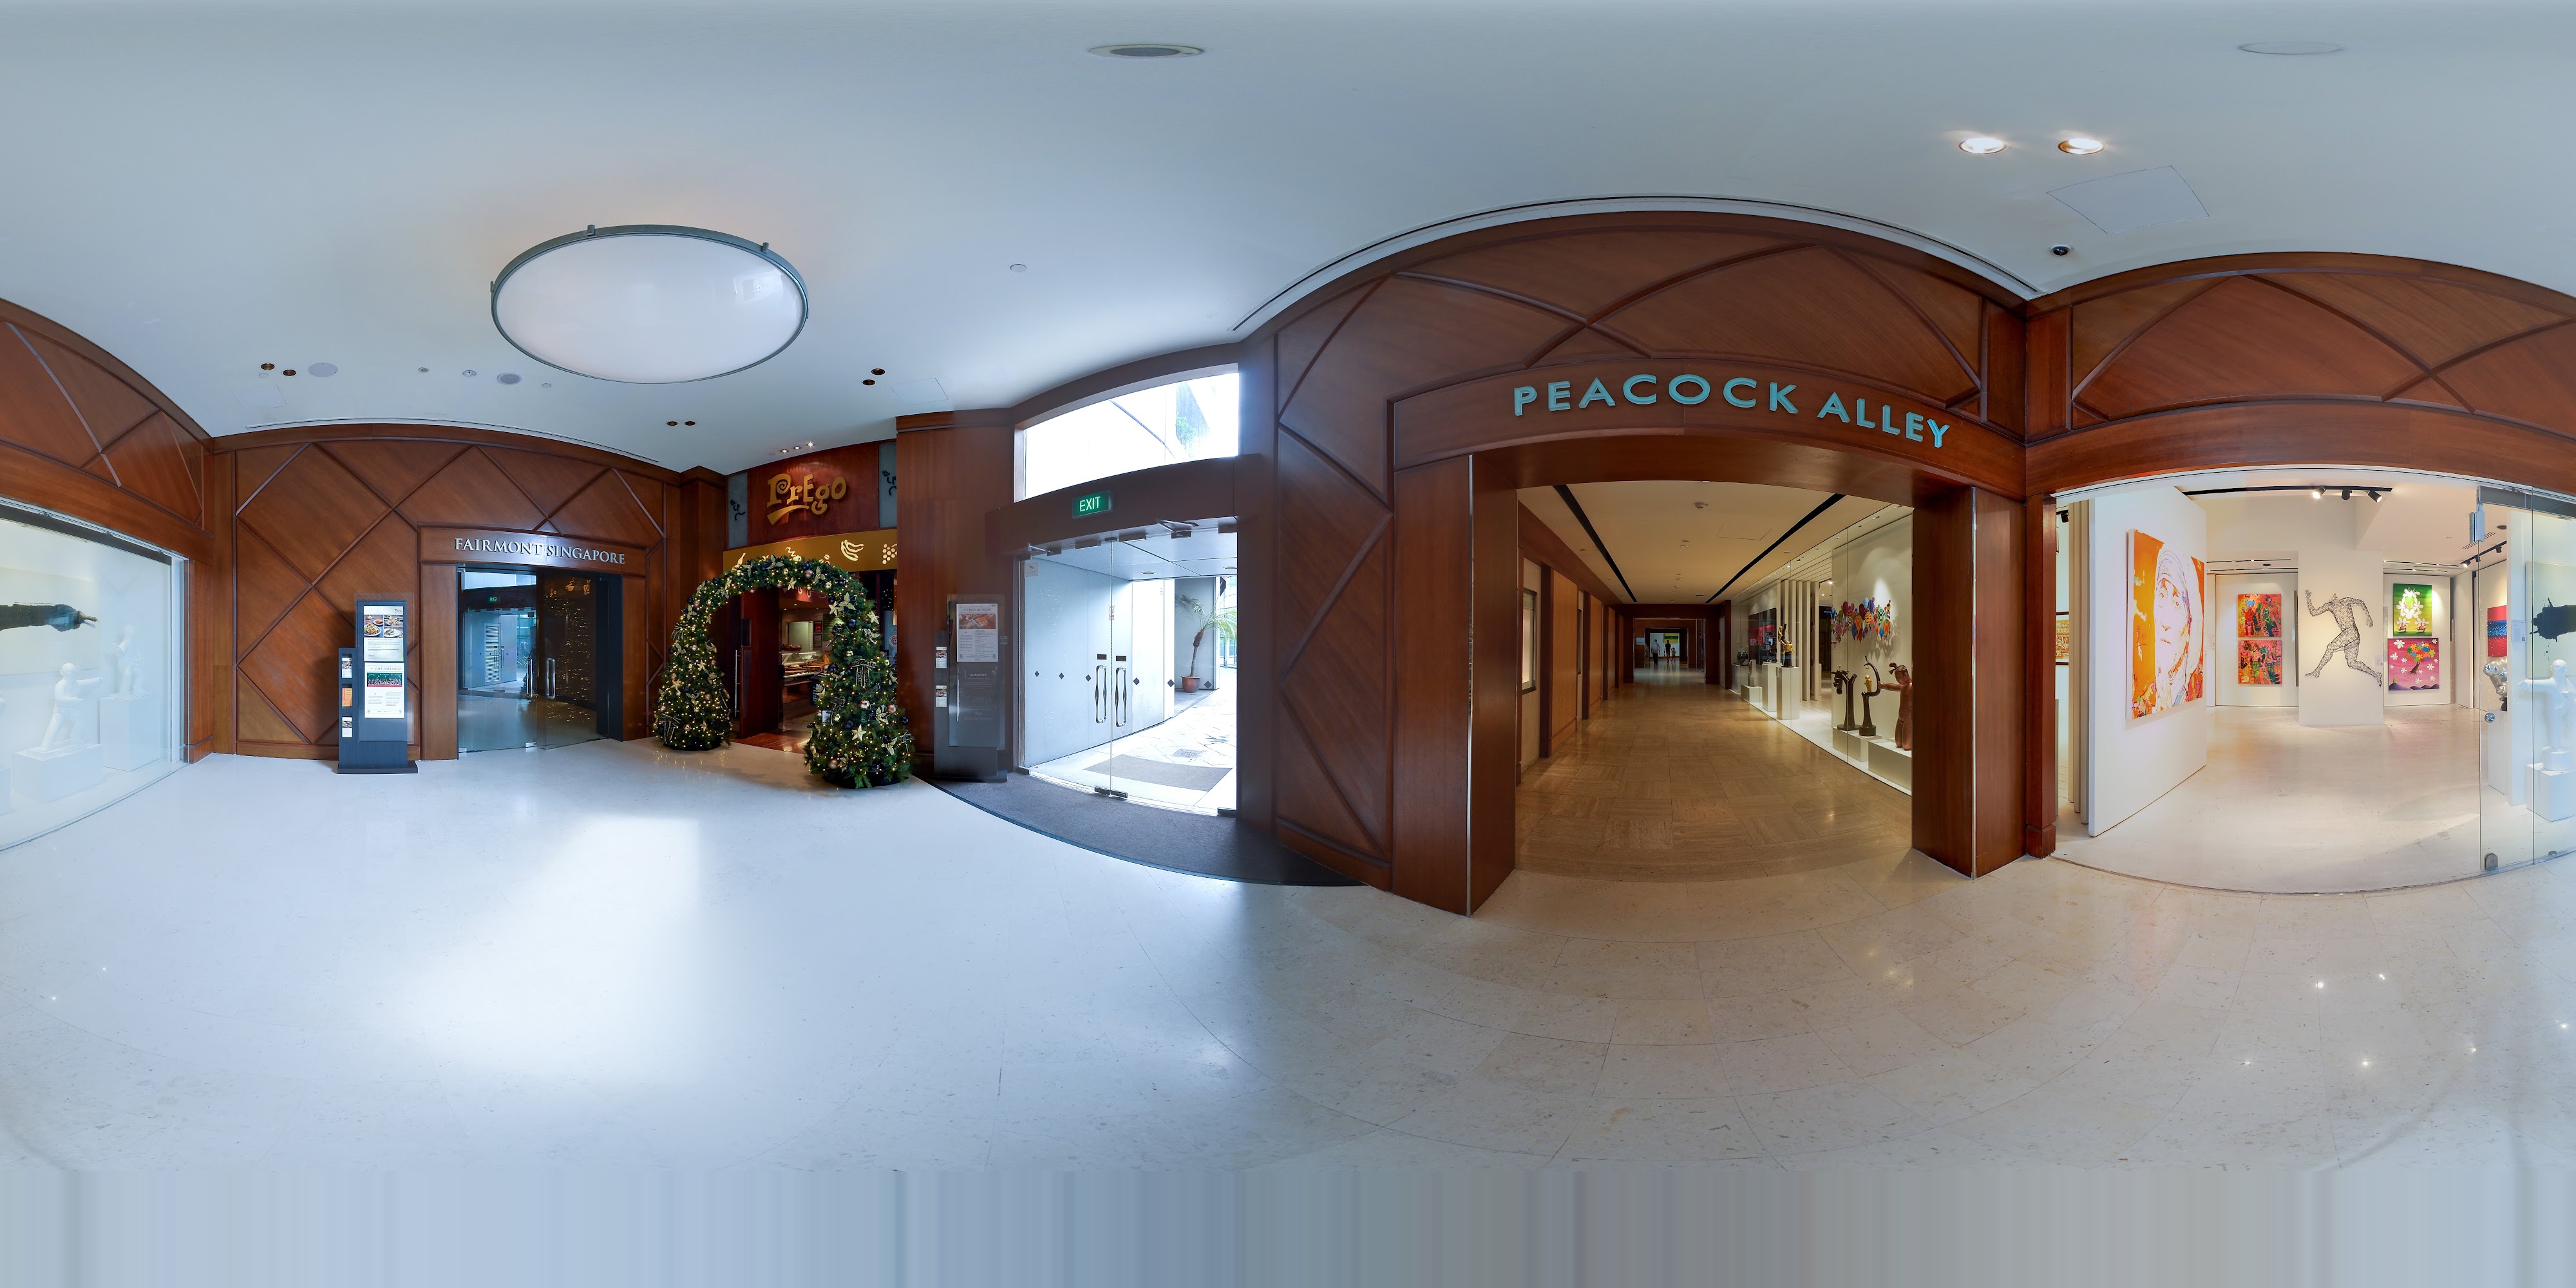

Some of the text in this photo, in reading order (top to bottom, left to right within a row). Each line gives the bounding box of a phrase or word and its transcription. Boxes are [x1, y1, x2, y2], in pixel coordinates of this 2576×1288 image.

[1513, 374, 1950, 448] PEACOCK ALLEY
[1079, 496, 1101, 512] EXIT
[455, 538, 625, 564] FAIRMONT SINGAPORE
